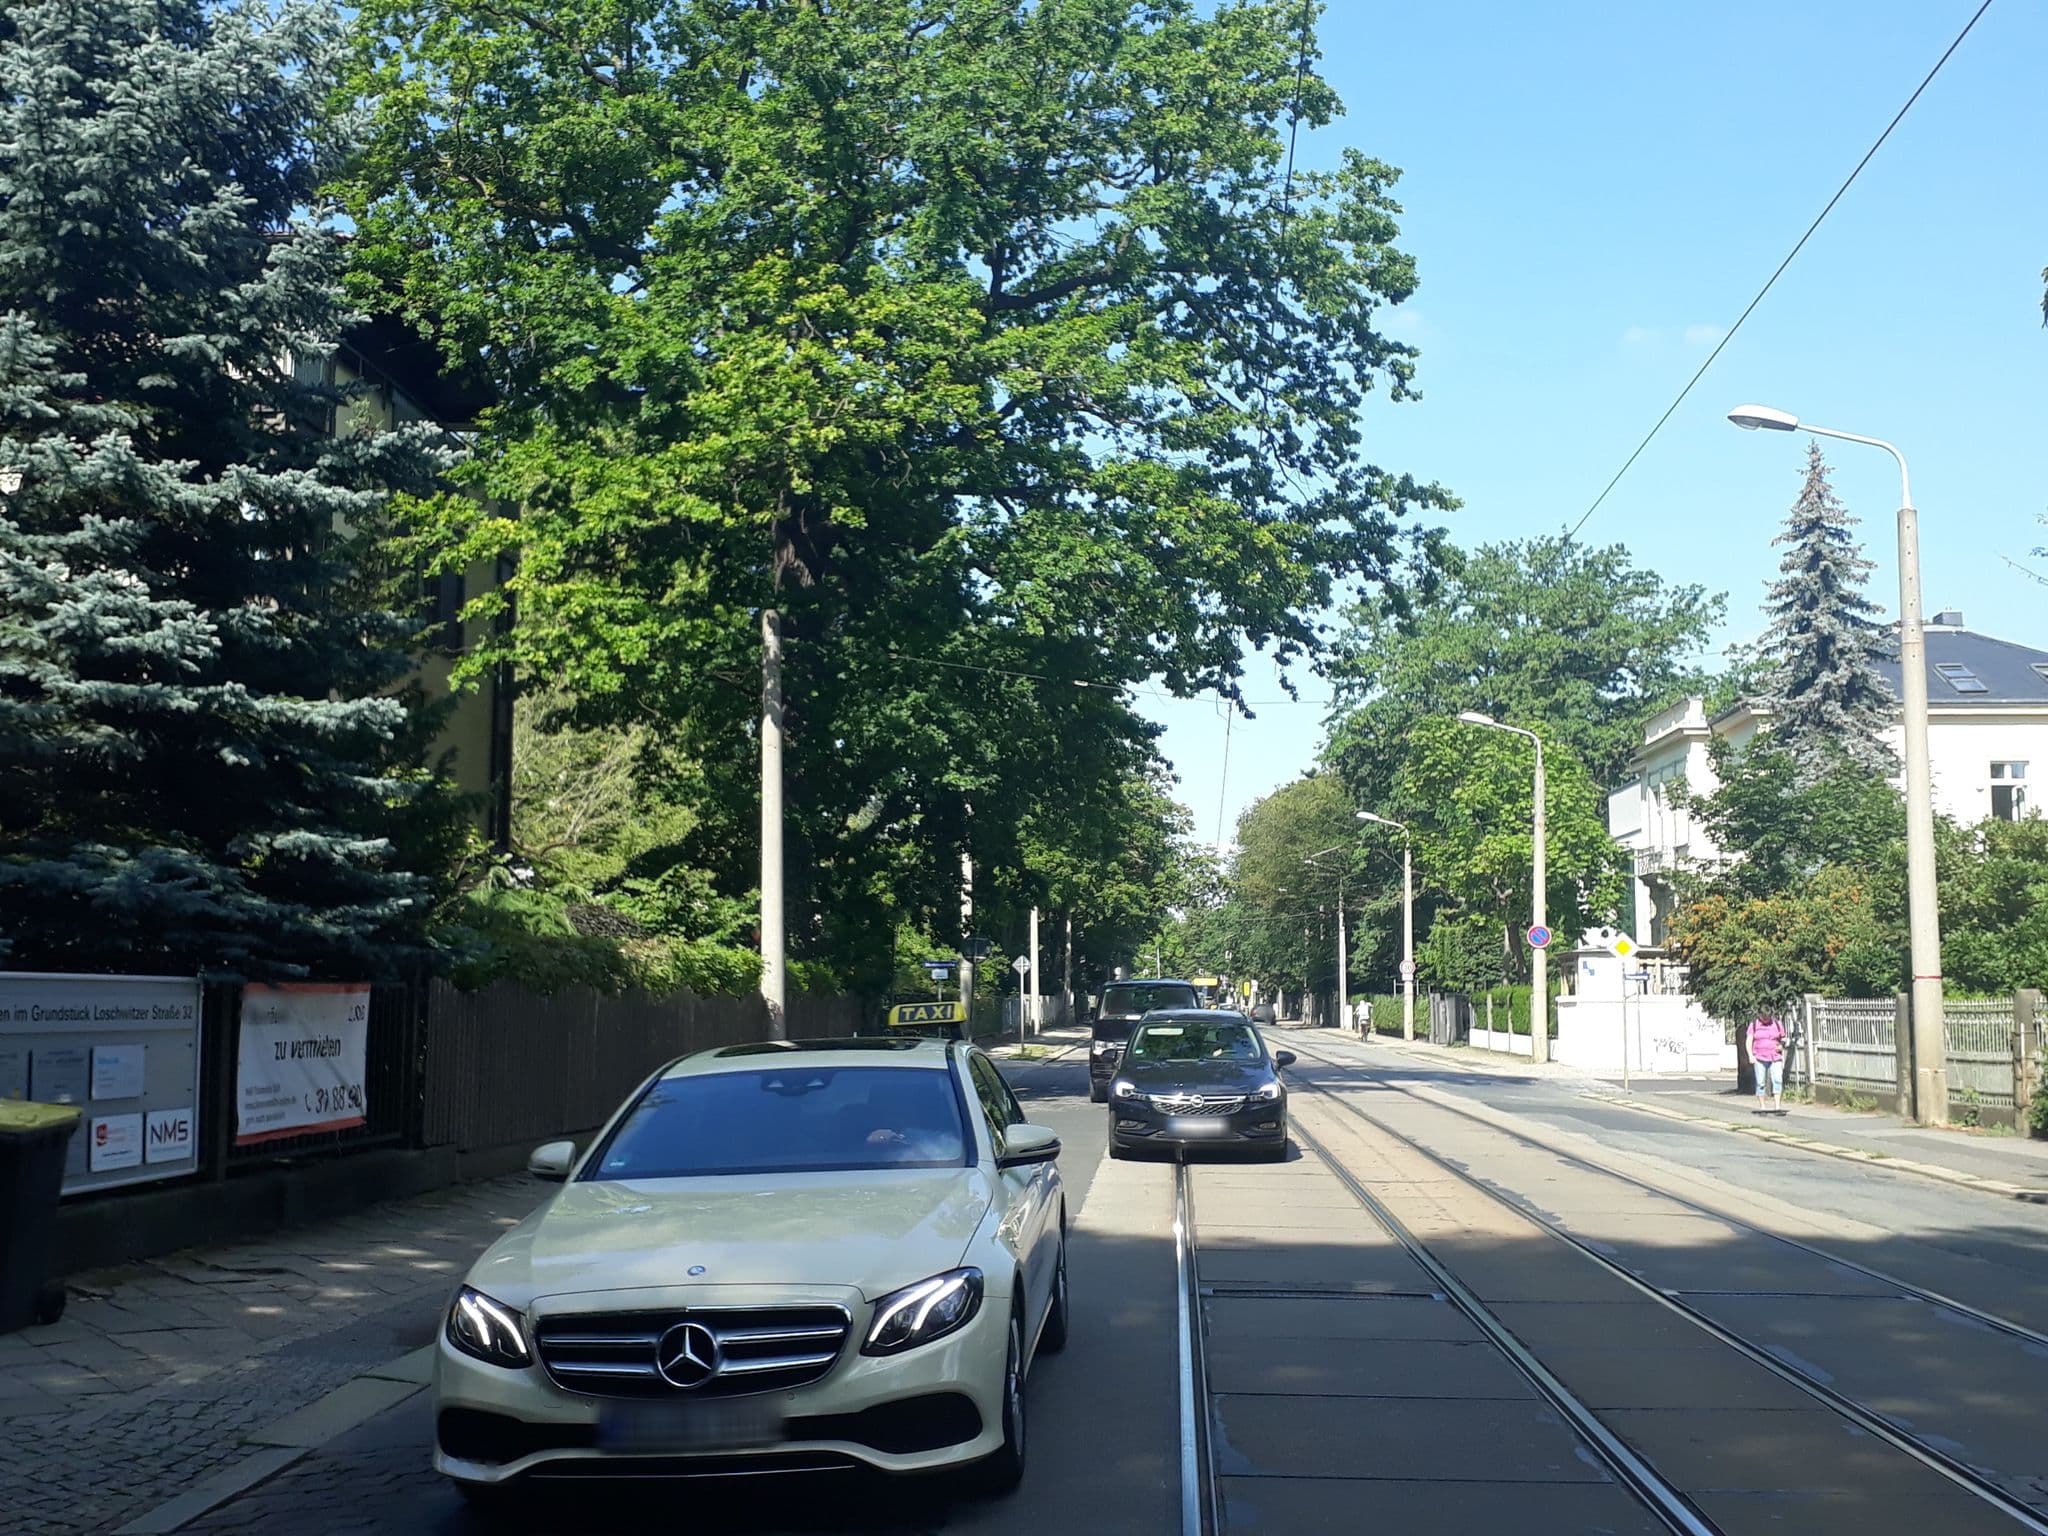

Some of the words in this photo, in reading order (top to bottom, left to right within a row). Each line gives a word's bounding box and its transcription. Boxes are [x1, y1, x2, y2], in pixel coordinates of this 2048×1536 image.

[14, 1004, 28, 1021] im
[31, 1005, 90, 1021] Grundstück
[94, 1004, 149, 1020] Loschwitzer
[152, 1003, 180, 1020] Straße
[902, 1005, 953, 1021] TAXI
[275, 1041, 287, 1060] zu
[291, 1034, 341, 1060] vermieten
[150, 1119, 188, 1144] NMS
